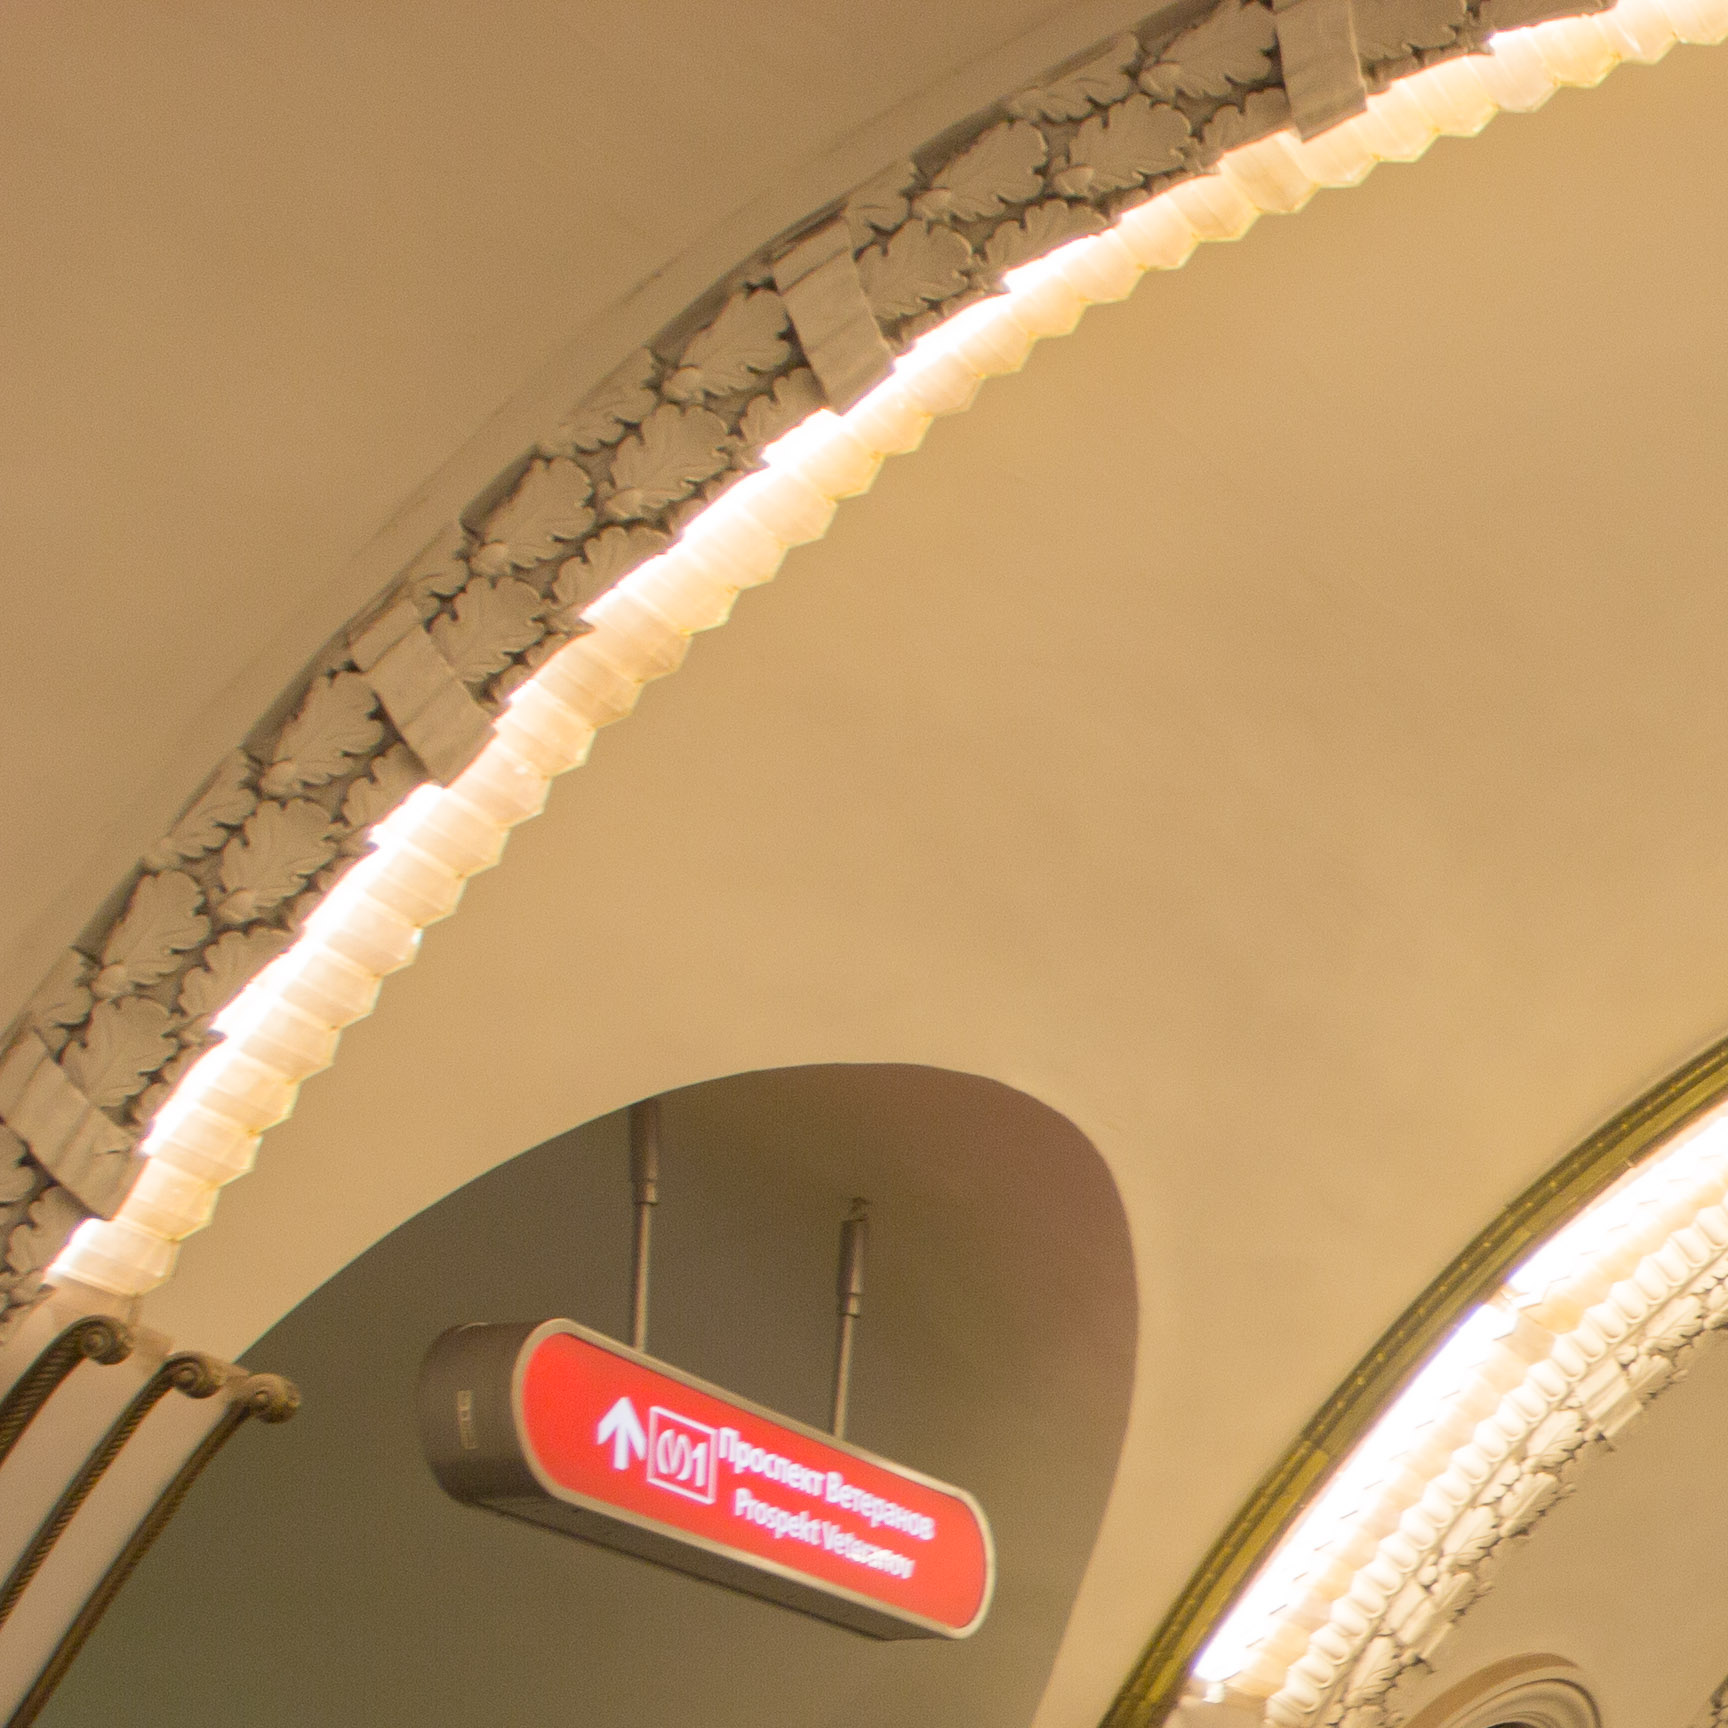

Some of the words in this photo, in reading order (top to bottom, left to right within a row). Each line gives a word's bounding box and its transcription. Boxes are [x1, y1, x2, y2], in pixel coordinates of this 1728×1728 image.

[717, 1427, 825, 1495] Проспект
[825, 1471, 936, 1541] Ветеранов
[734, 1487, 821, 1546] Prospekt
[822, 1521, 915, 1579] Veteranov
